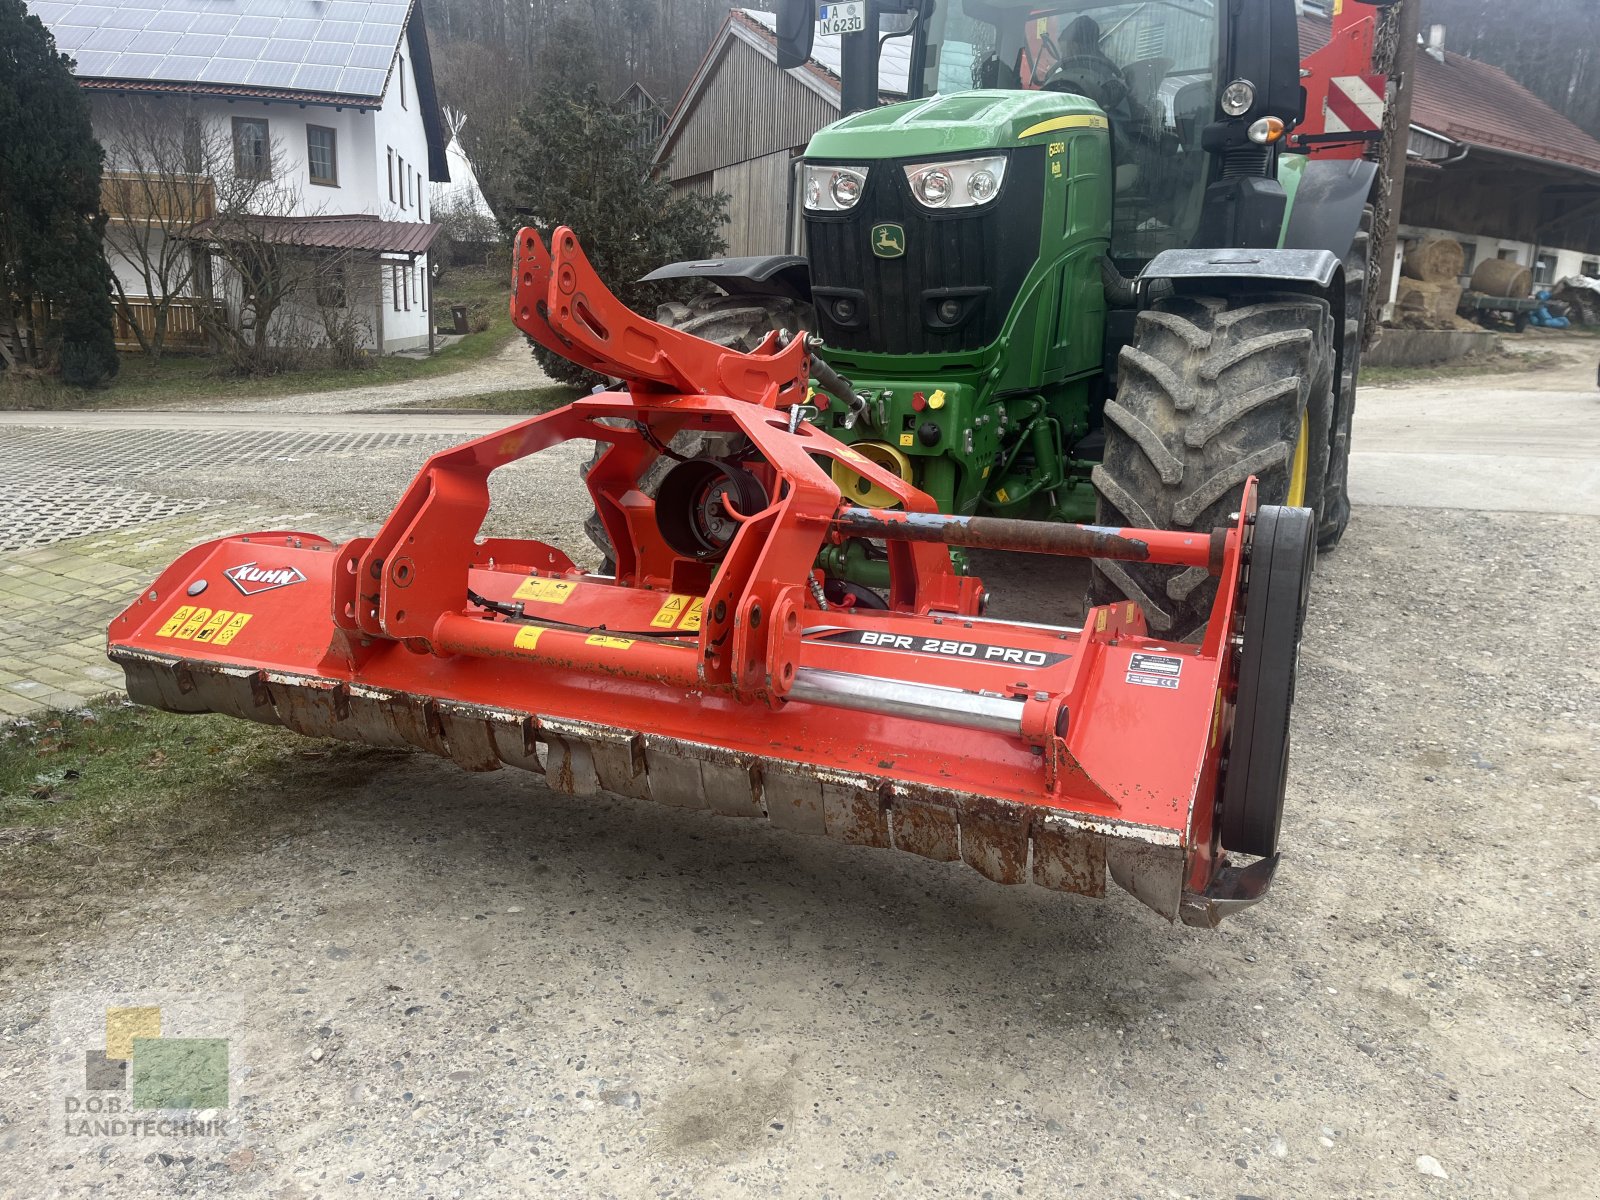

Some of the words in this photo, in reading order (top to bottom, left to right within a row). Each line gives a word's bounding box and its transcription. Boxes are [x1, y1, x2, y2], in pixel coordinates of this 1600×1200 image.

[832, 6, 838, 18] A
[823, 20, 830, 34] N
[233, 566, 296, 584] KUHN
[860, 631, 913, 650] BPR
[921, 639, 977, 657] 280
[985, 646, 1047, 666] PRO
